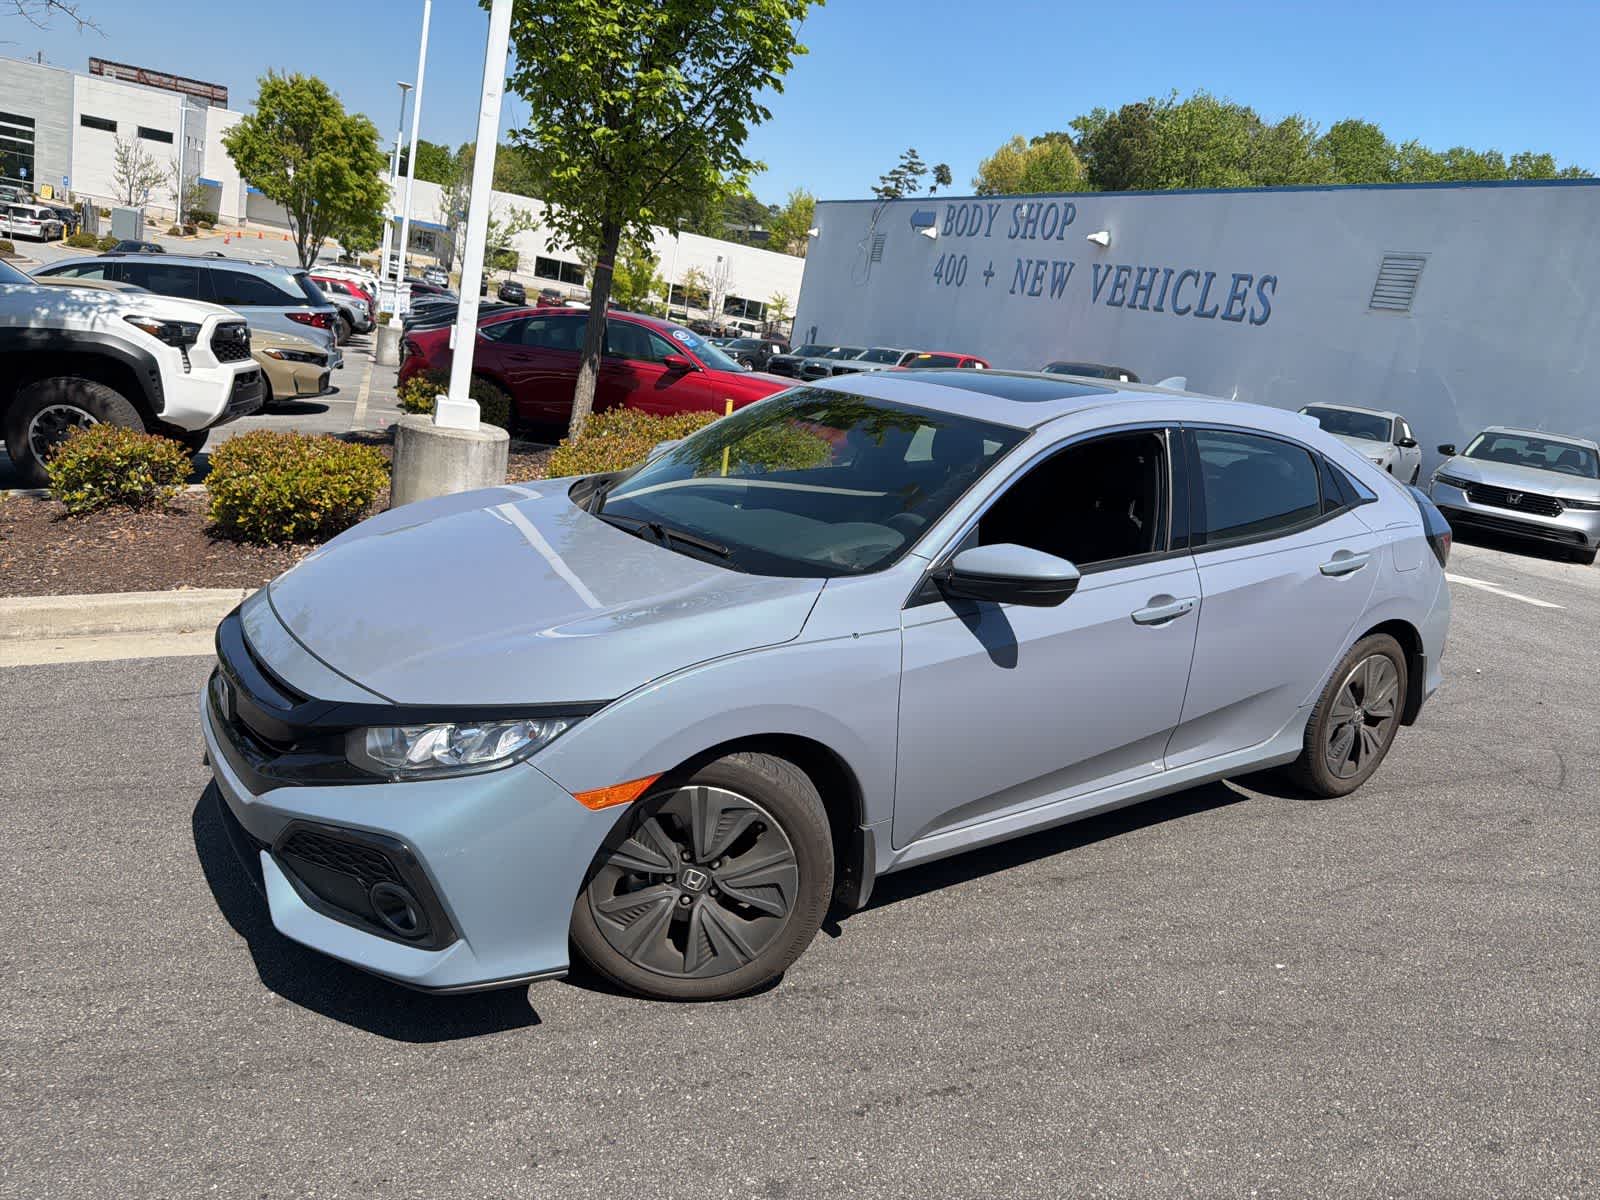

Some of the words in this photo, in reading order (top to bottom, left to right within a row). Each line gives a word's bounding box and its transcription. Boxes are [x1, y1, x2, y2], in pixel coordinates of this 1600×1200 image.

[941, 203, 1001, 237] BODY
[1008, 202, 1077, 241] SHOP
[933, 253, 968, 288] 400
[983, 260, 995, 288] +
[1009, 257, 1076, 299] NEW
[1091, 263, 1278, 327] VEHICLES
